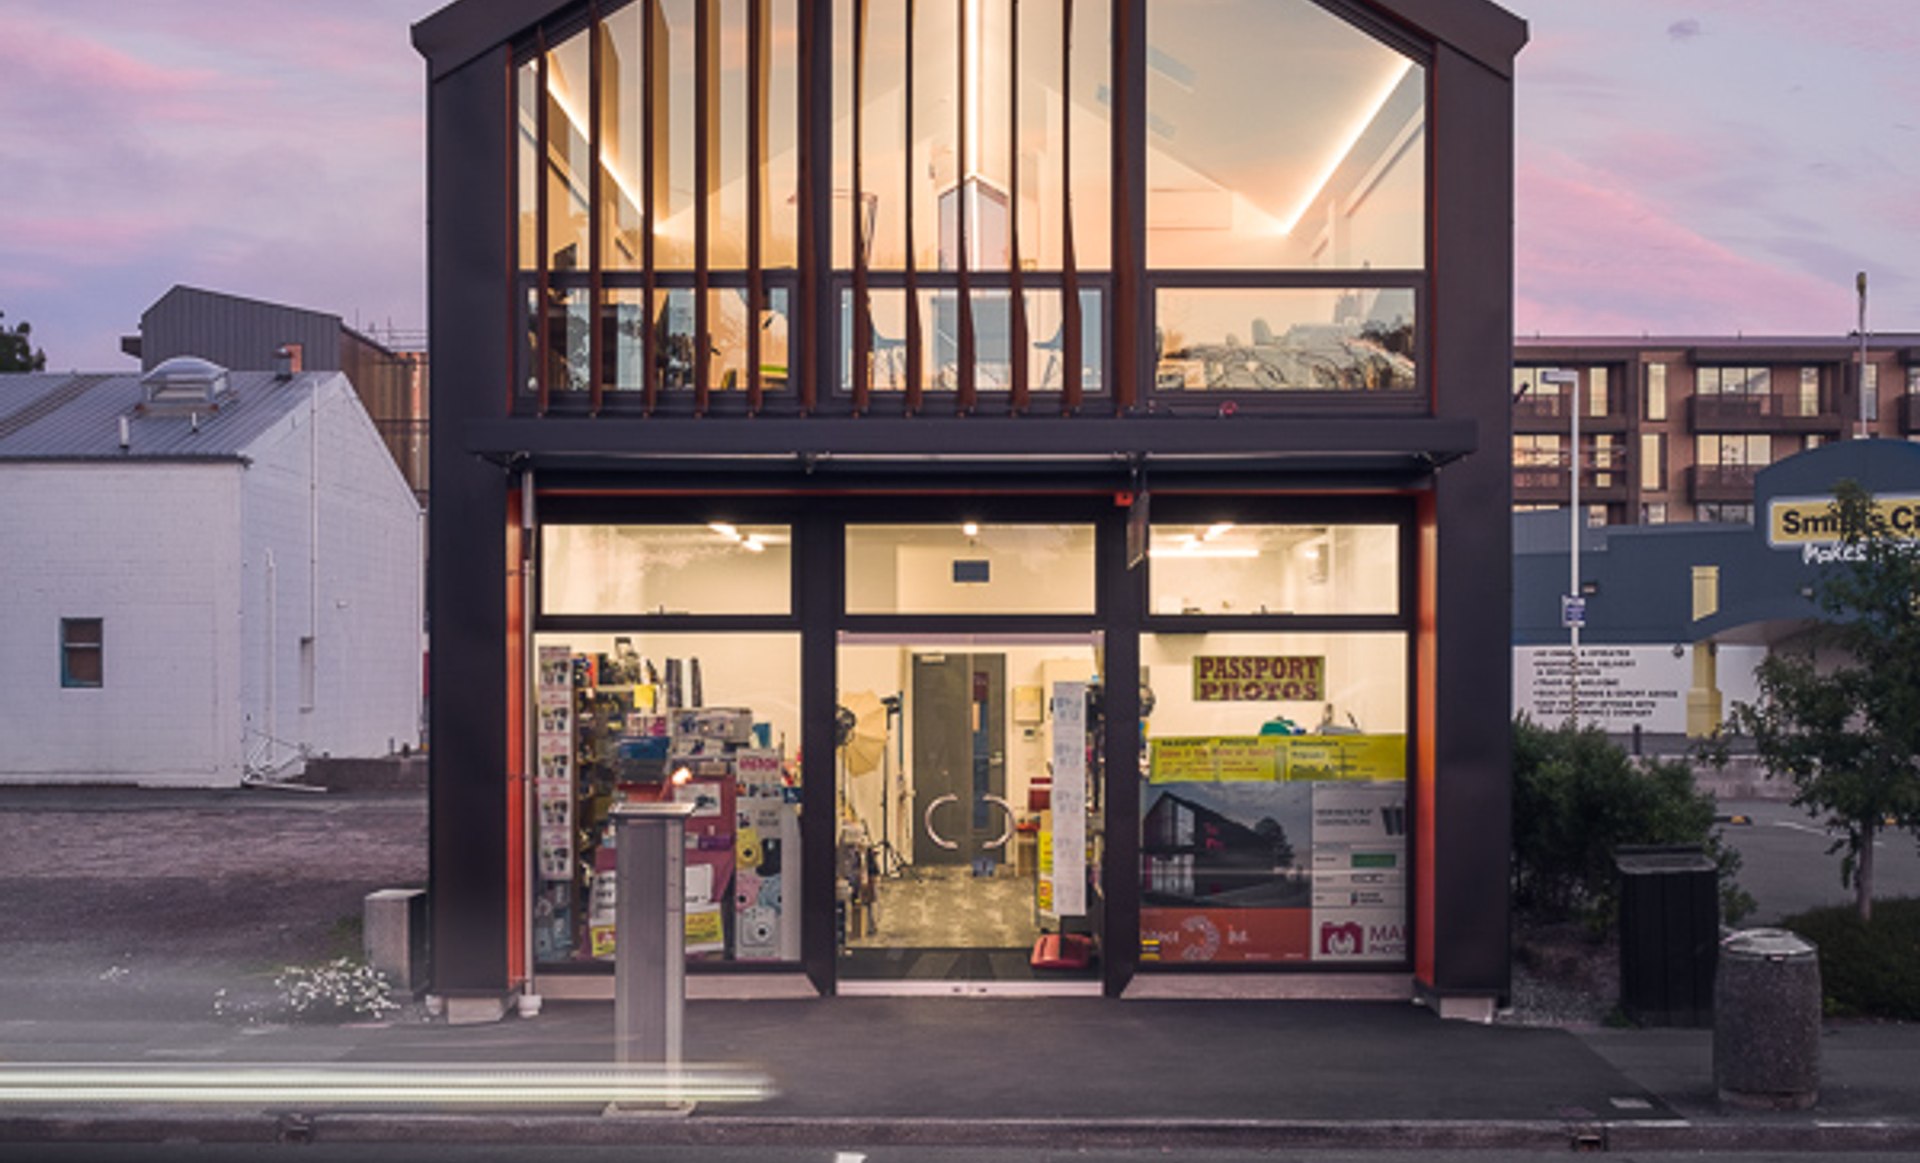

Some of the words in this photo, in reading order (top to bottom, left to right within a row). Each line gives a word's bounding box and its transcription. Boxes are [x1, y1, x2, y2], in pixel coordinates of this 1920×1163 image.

[1782, 507, 1885, 534] Smis
[1200, 656, 1319, 679] PASSPORT
[1200, 682, 1318, 700] PHOTOS
[1370, 925, 1407, 941] MA
